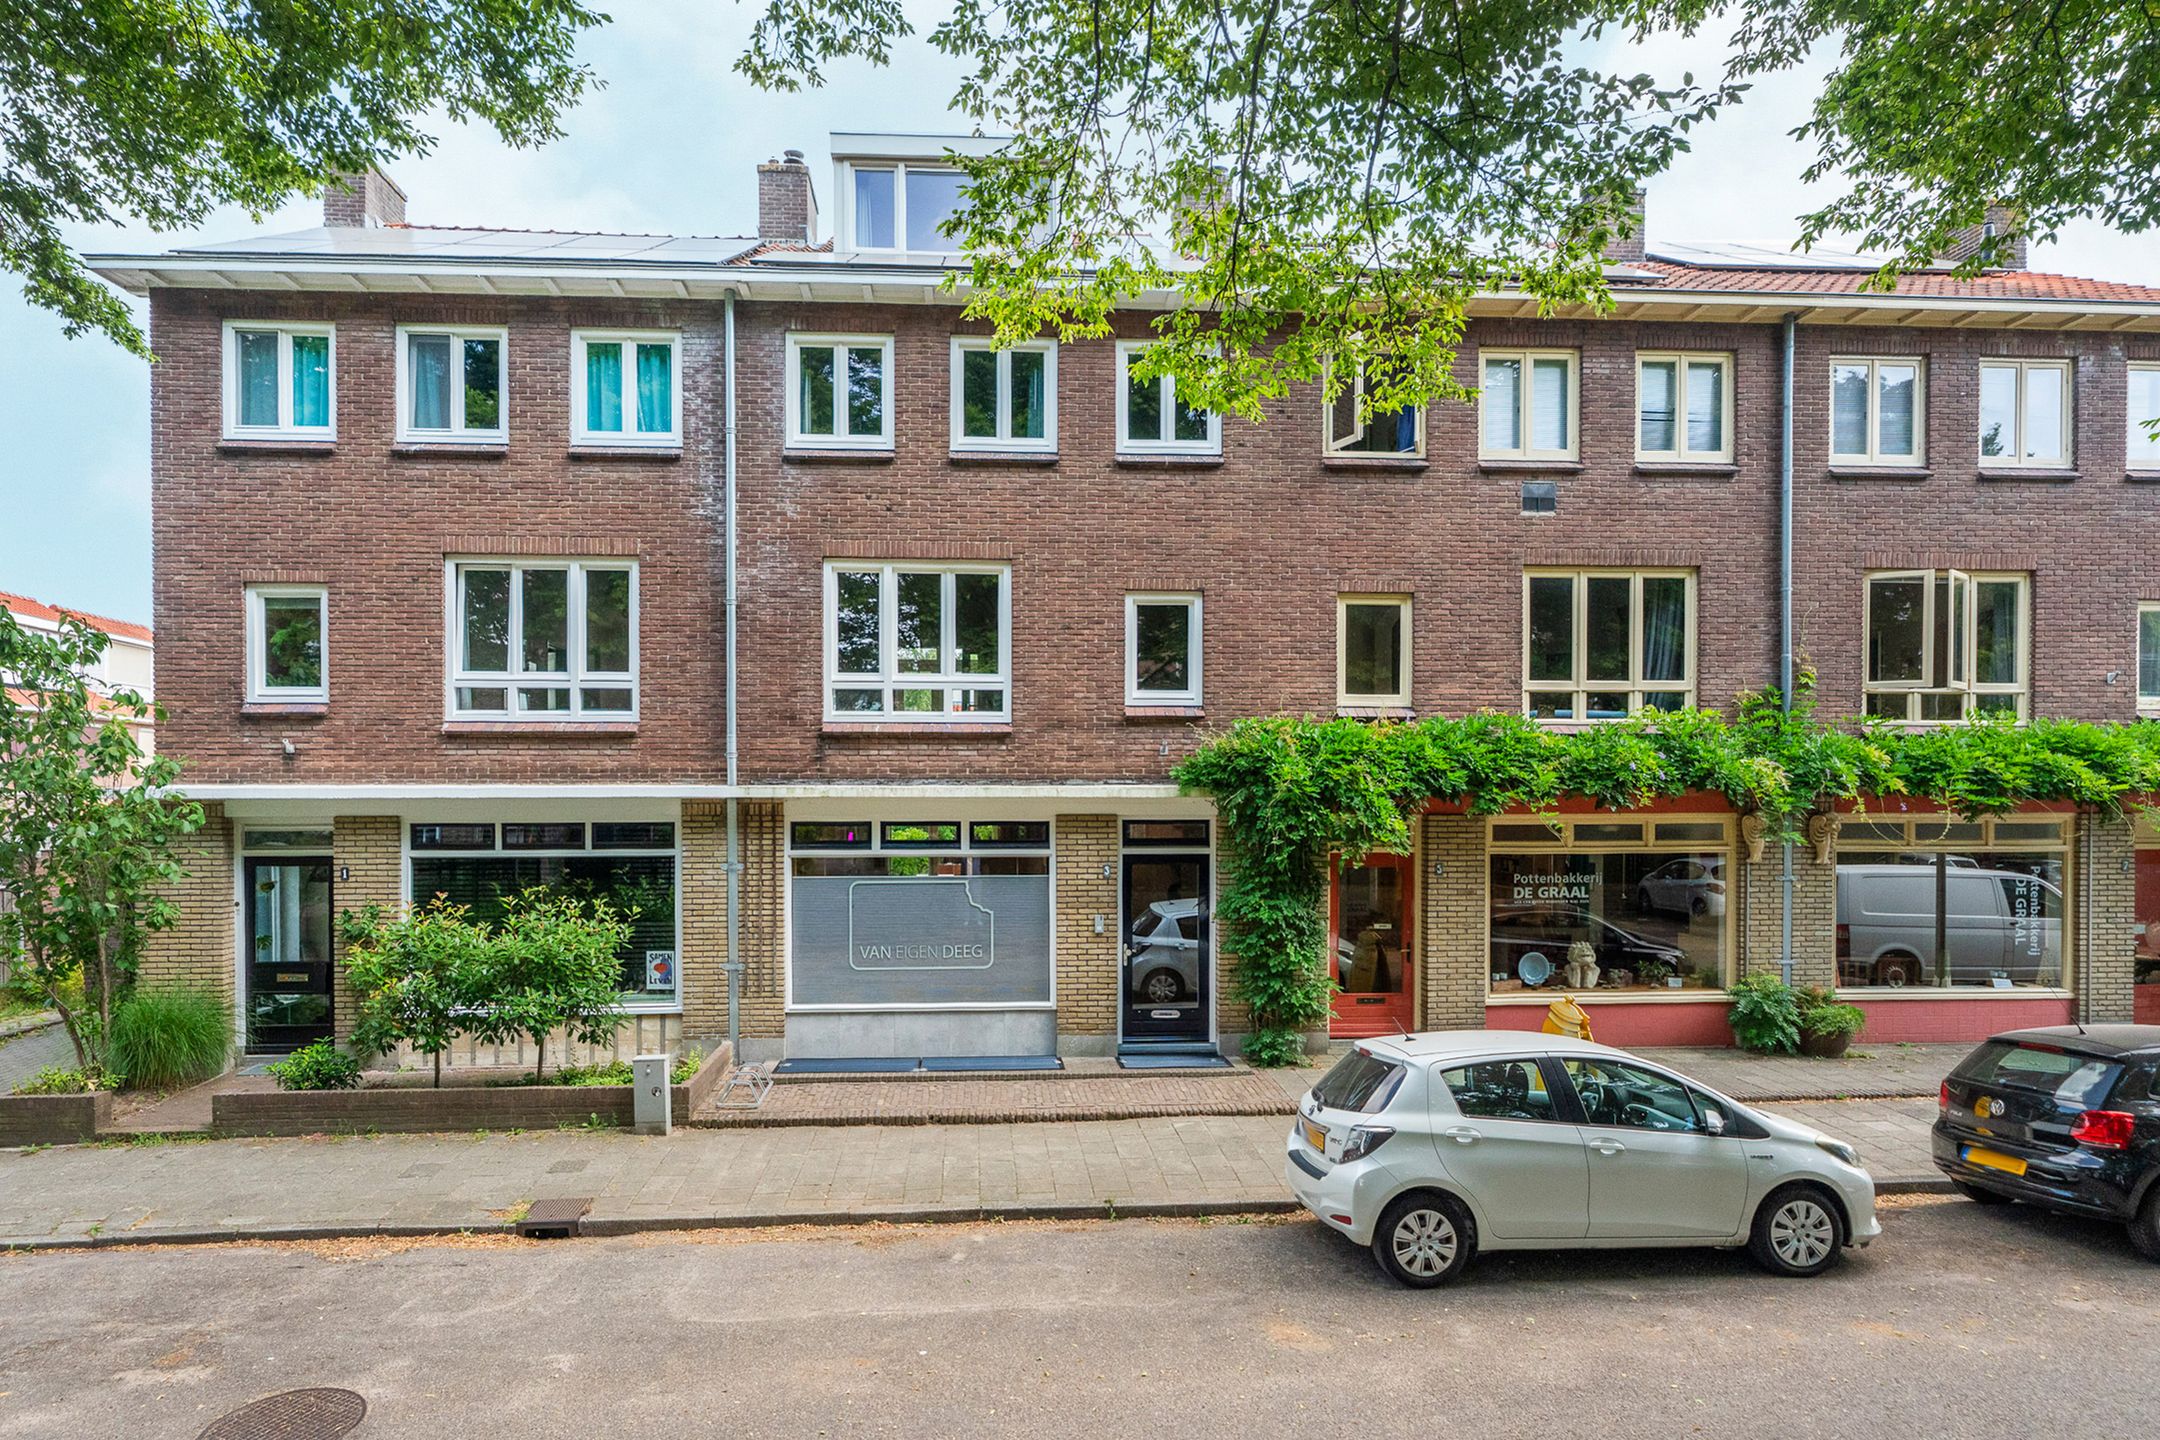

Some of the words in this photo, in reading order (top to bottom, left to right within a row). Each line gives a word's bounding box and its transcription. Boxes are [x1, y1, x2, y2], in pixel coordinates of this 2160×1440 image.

[1513, 872, 1603, 886] Pottenbakkerij
[2015, 879, 2027, 895] DE
[1513, 887, 1533, 899] DE
[1538, 886, 1589, 898] GRAAL
[2027, 866, 2041, 956] Pottenbakkerij
[2015, 898, 2027, 945] GRAAL
[859, 945, 891, 960] VAN
[896, 945, 939, 959] EIGEN
[942, 944, 983, 958] DEEG
